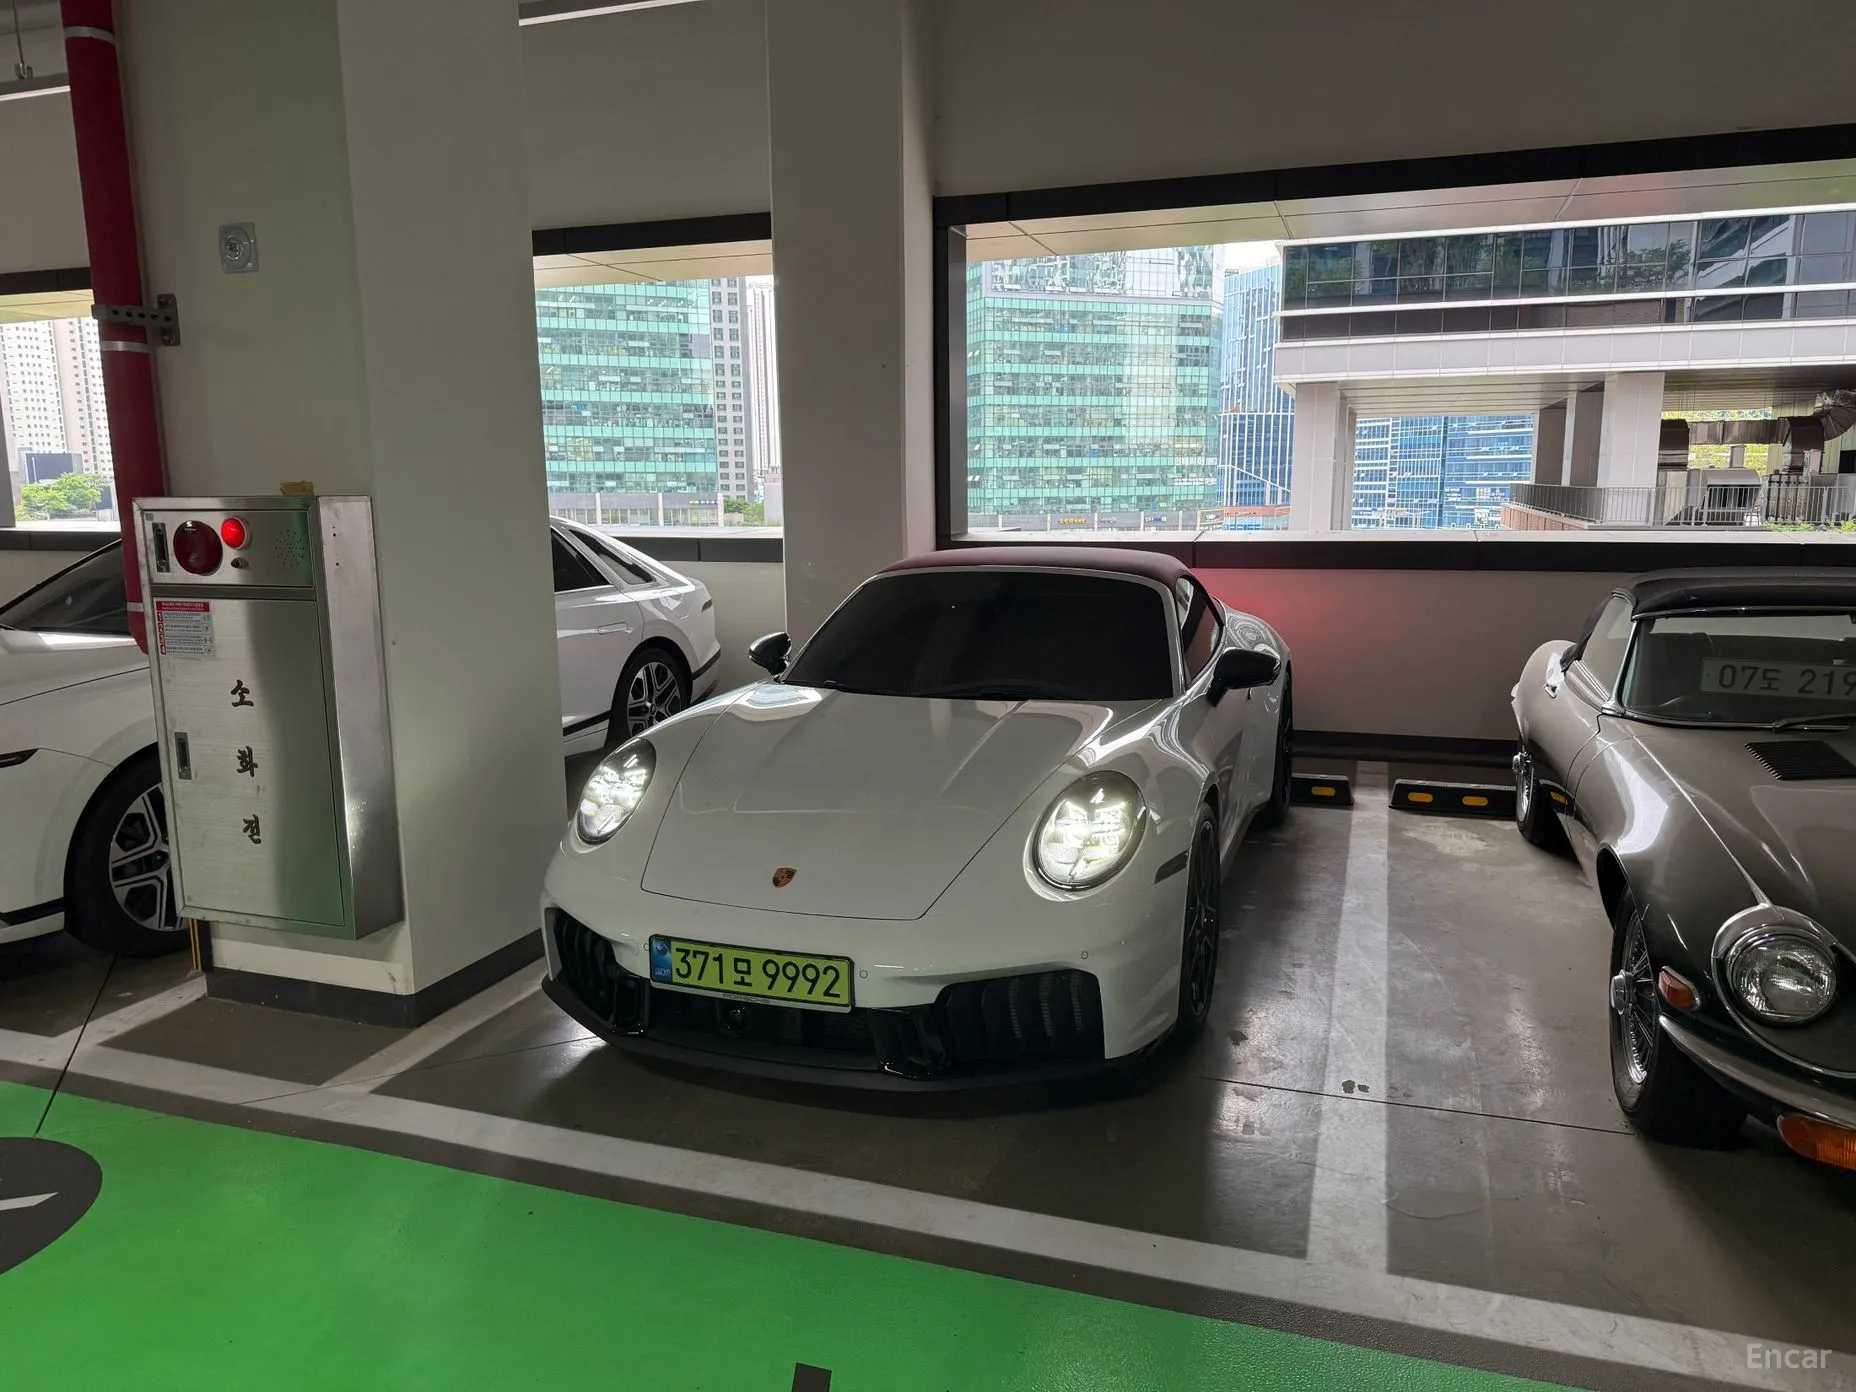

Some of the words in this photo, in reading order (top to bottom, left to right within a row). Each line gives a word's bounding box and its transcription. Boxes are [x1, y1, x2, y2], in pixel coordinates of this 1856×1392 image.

[1719, 664, 1781, 691] 07도
[230, 679, 262, 844] 소화전
[675, 947, 753, 987] 371모
[762, 959, 841, 998] 9992
